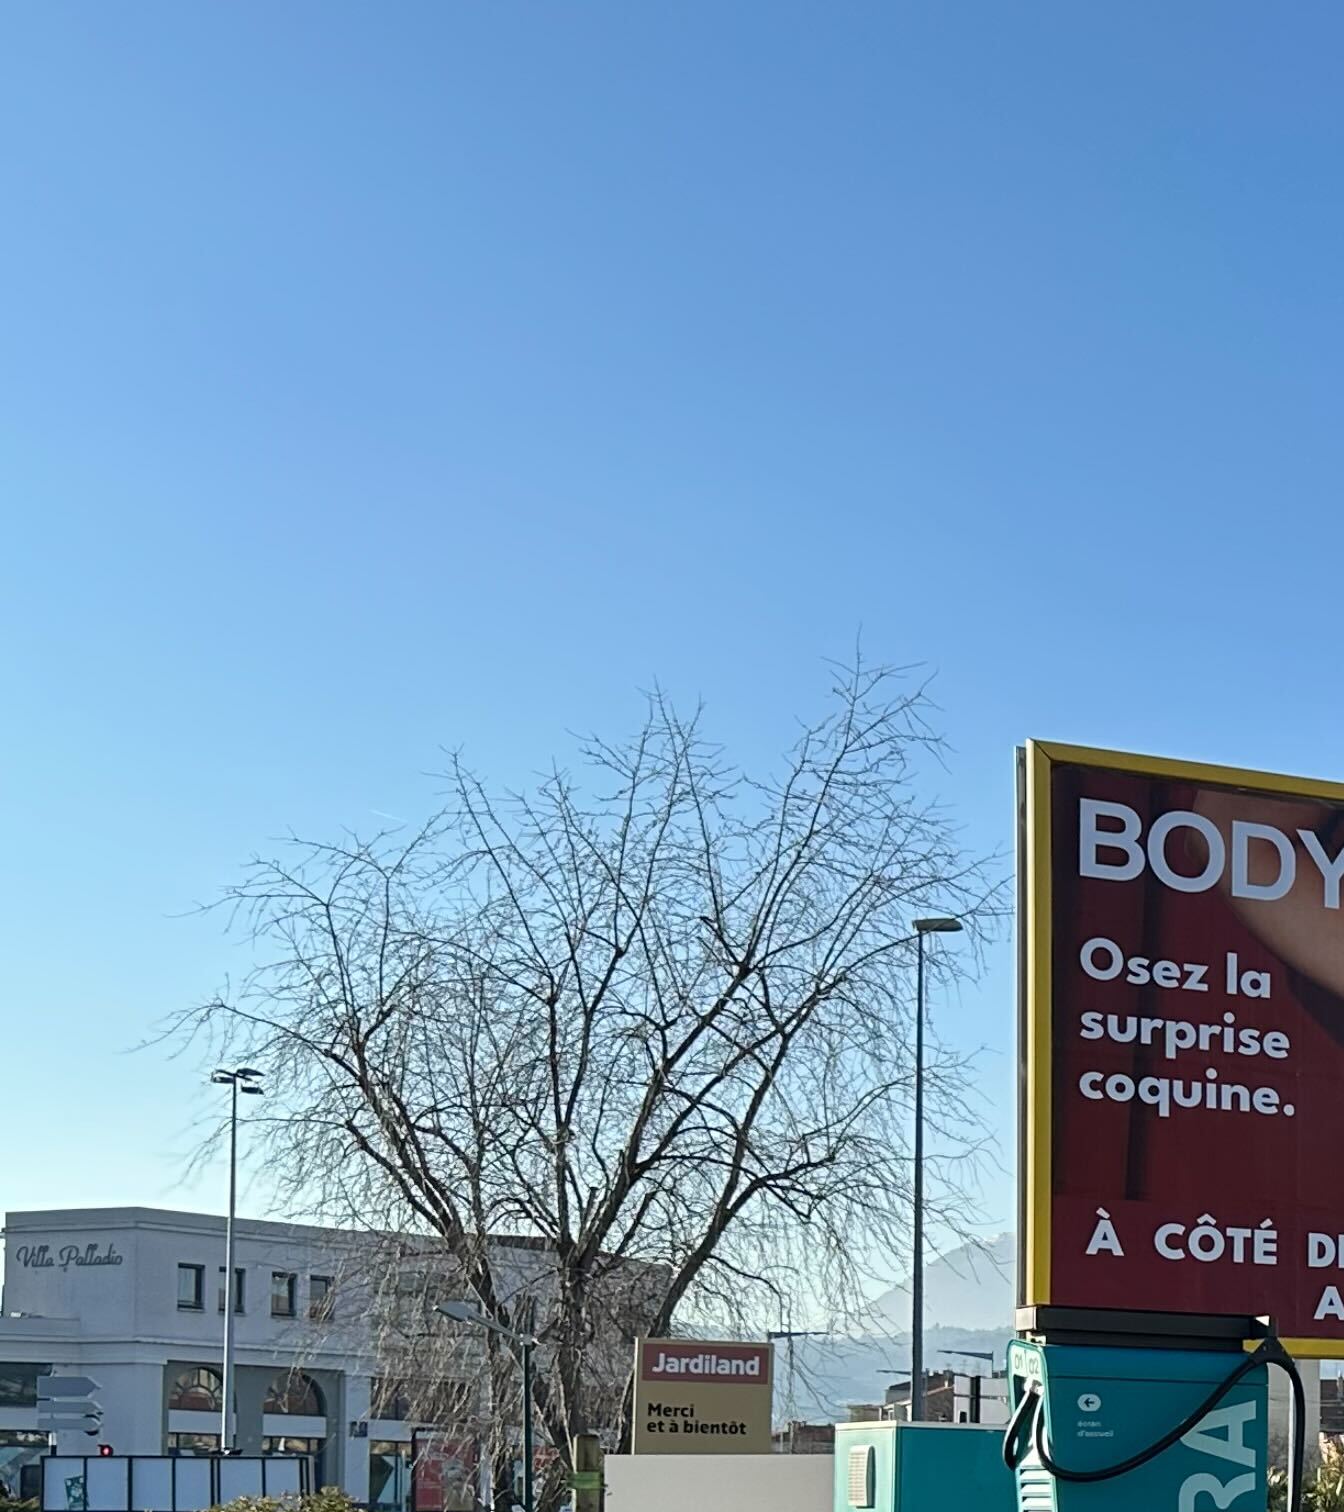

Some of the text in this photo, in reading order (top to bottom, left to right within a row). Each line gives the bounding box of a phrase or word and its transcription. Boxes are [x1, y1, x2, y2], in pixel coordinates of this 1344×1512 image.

[1080, 937, 1271, 998] Osez la
[1080, 1011, 1290, 1059] surprise
[1079, 1067, 1295, 1117] coquine.
[1085, 1207, 1125, 1256] À
[1154, 1213, 1277, 1265] CÔTÉ
[16, 1243, 123, 1268] Villa Palladio
[652, 1353, 760, 1376] Jardiland
[647, 1420, 746, 1435] et à bientôt
[648, 1403, 694, 1418] Merci
